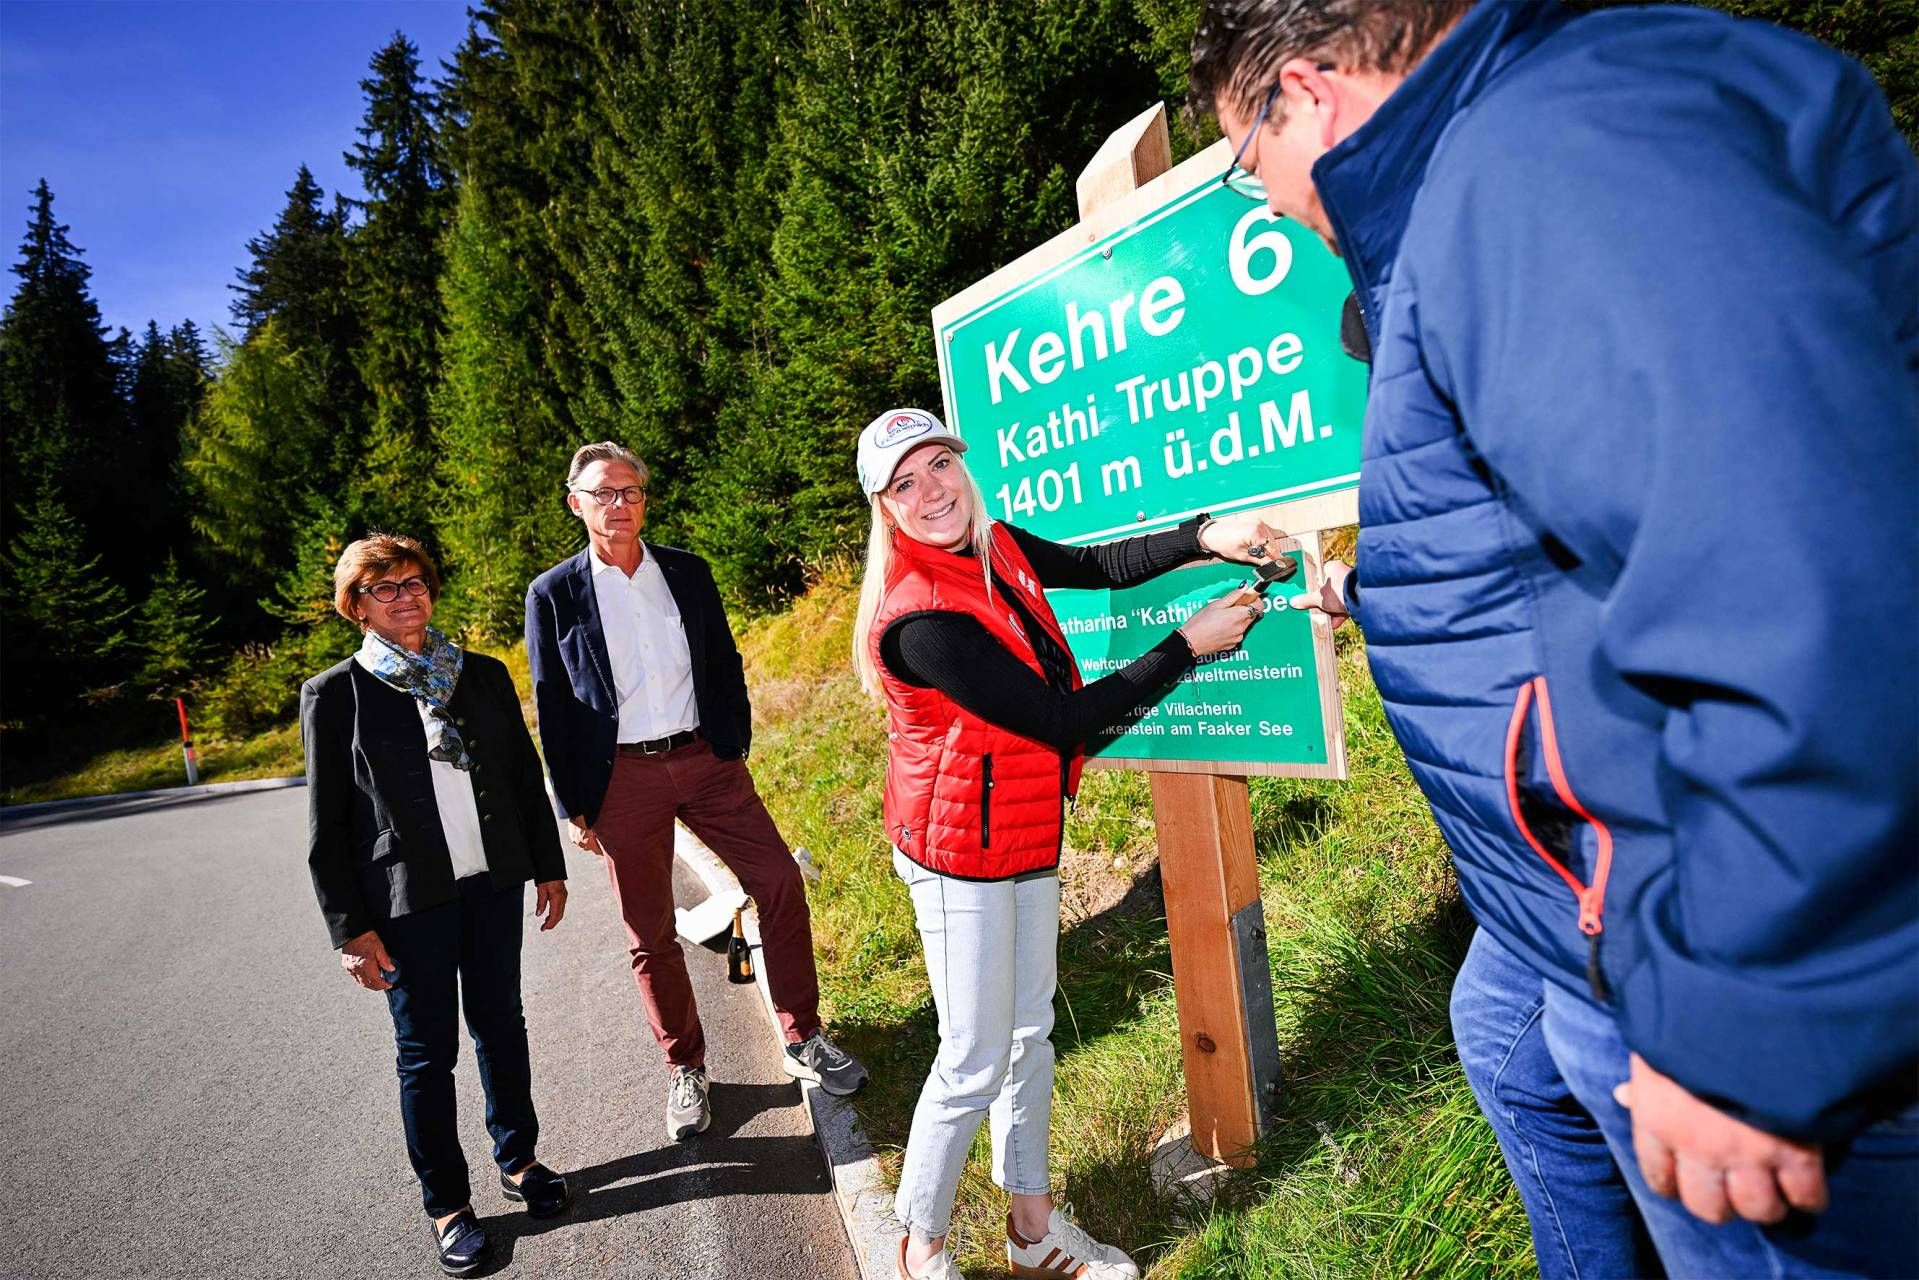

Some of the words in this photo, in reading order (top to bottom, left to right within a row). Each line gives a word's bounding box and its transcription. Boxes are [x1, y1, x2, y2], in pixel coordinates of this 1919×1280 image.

[984, 275, 1186, 405] Kehre
[1228, 204, 1293, 296] 6
[998, 394, 1099, 468] Kathi
[1115, 332, 1304, 426] Truppe
[996, 462, 1084, 522] 1401
[1102, 455, 1142, 497] m
[1163, 389, 1333, 480] ü.d.M.
[1059, 613, 1128, 635] atharina
[1164, 702, 1242, 717] Villacherin
[1170, 725, 1193, 736] am
[1198, 722, 1251, 736] Faaker
[1258, 720, 1293, 736] See
